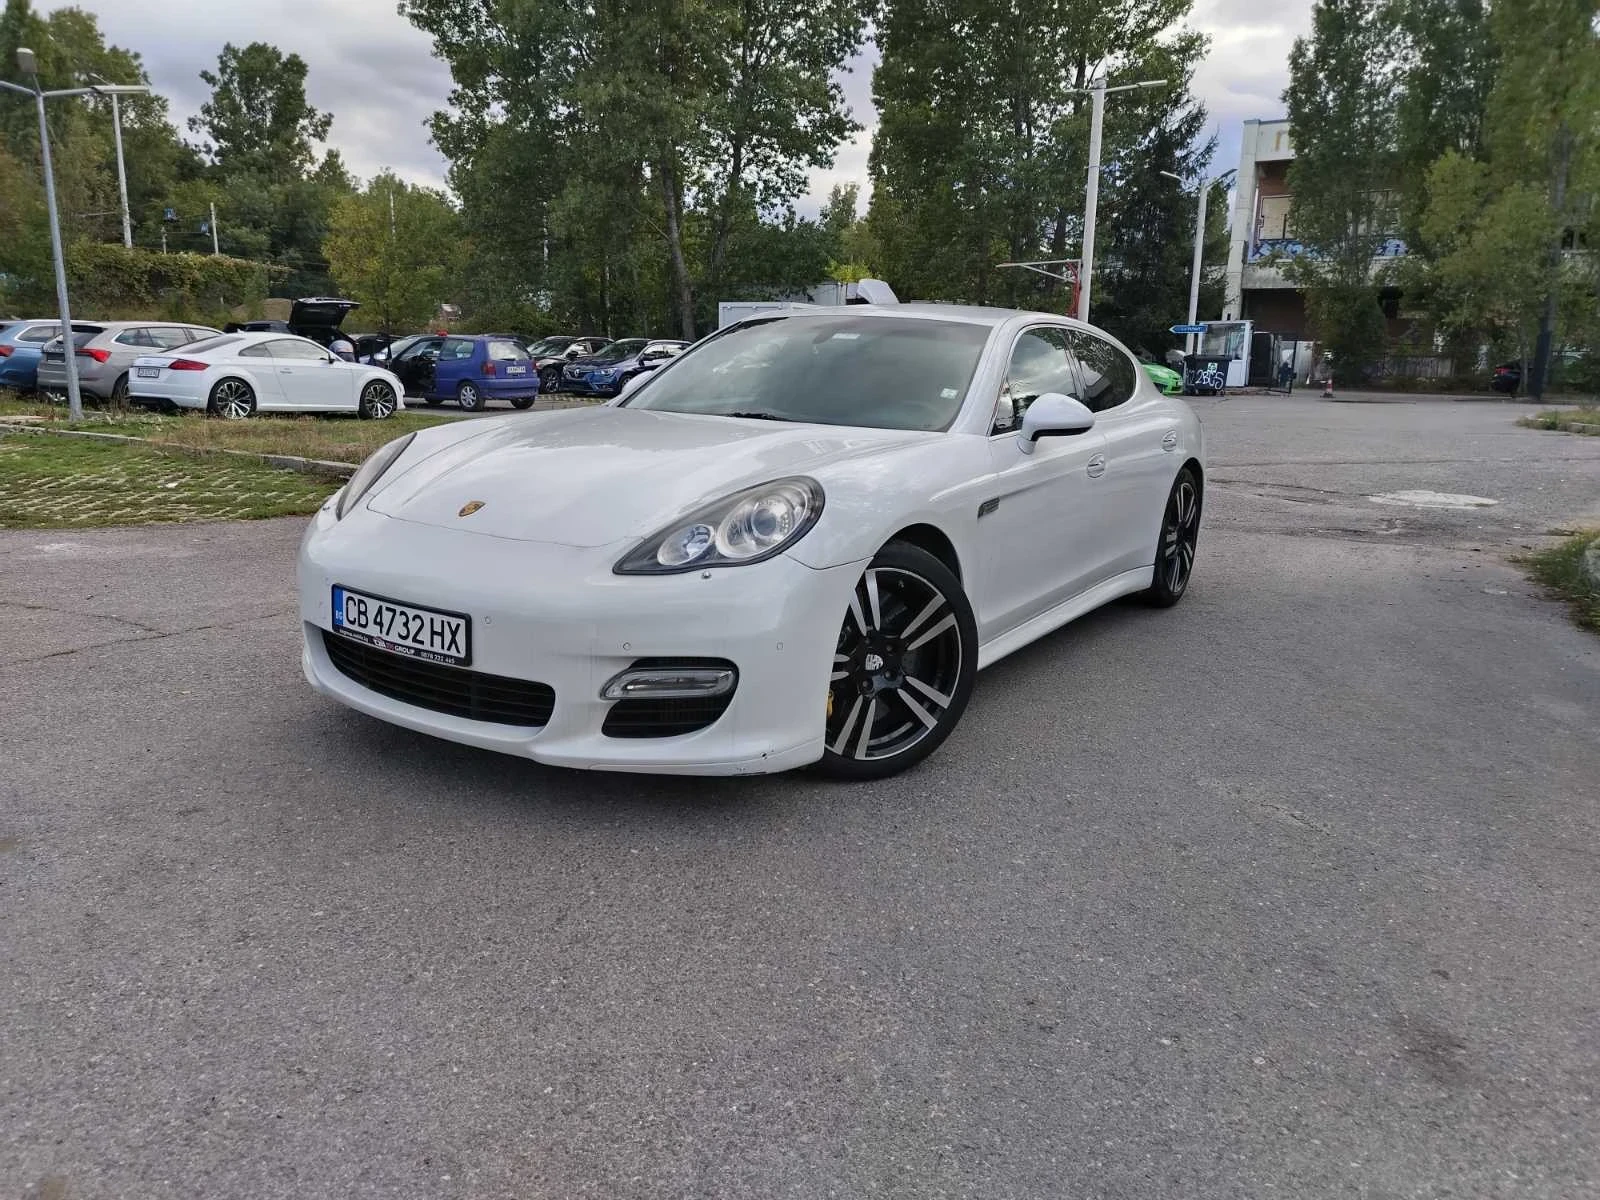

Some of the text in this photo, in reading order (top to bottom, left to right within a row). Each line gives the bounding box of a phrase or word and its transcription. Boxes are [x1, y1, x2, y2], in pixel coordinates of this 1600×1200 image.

[346, 596, 461, 654] CB 4732 HX
